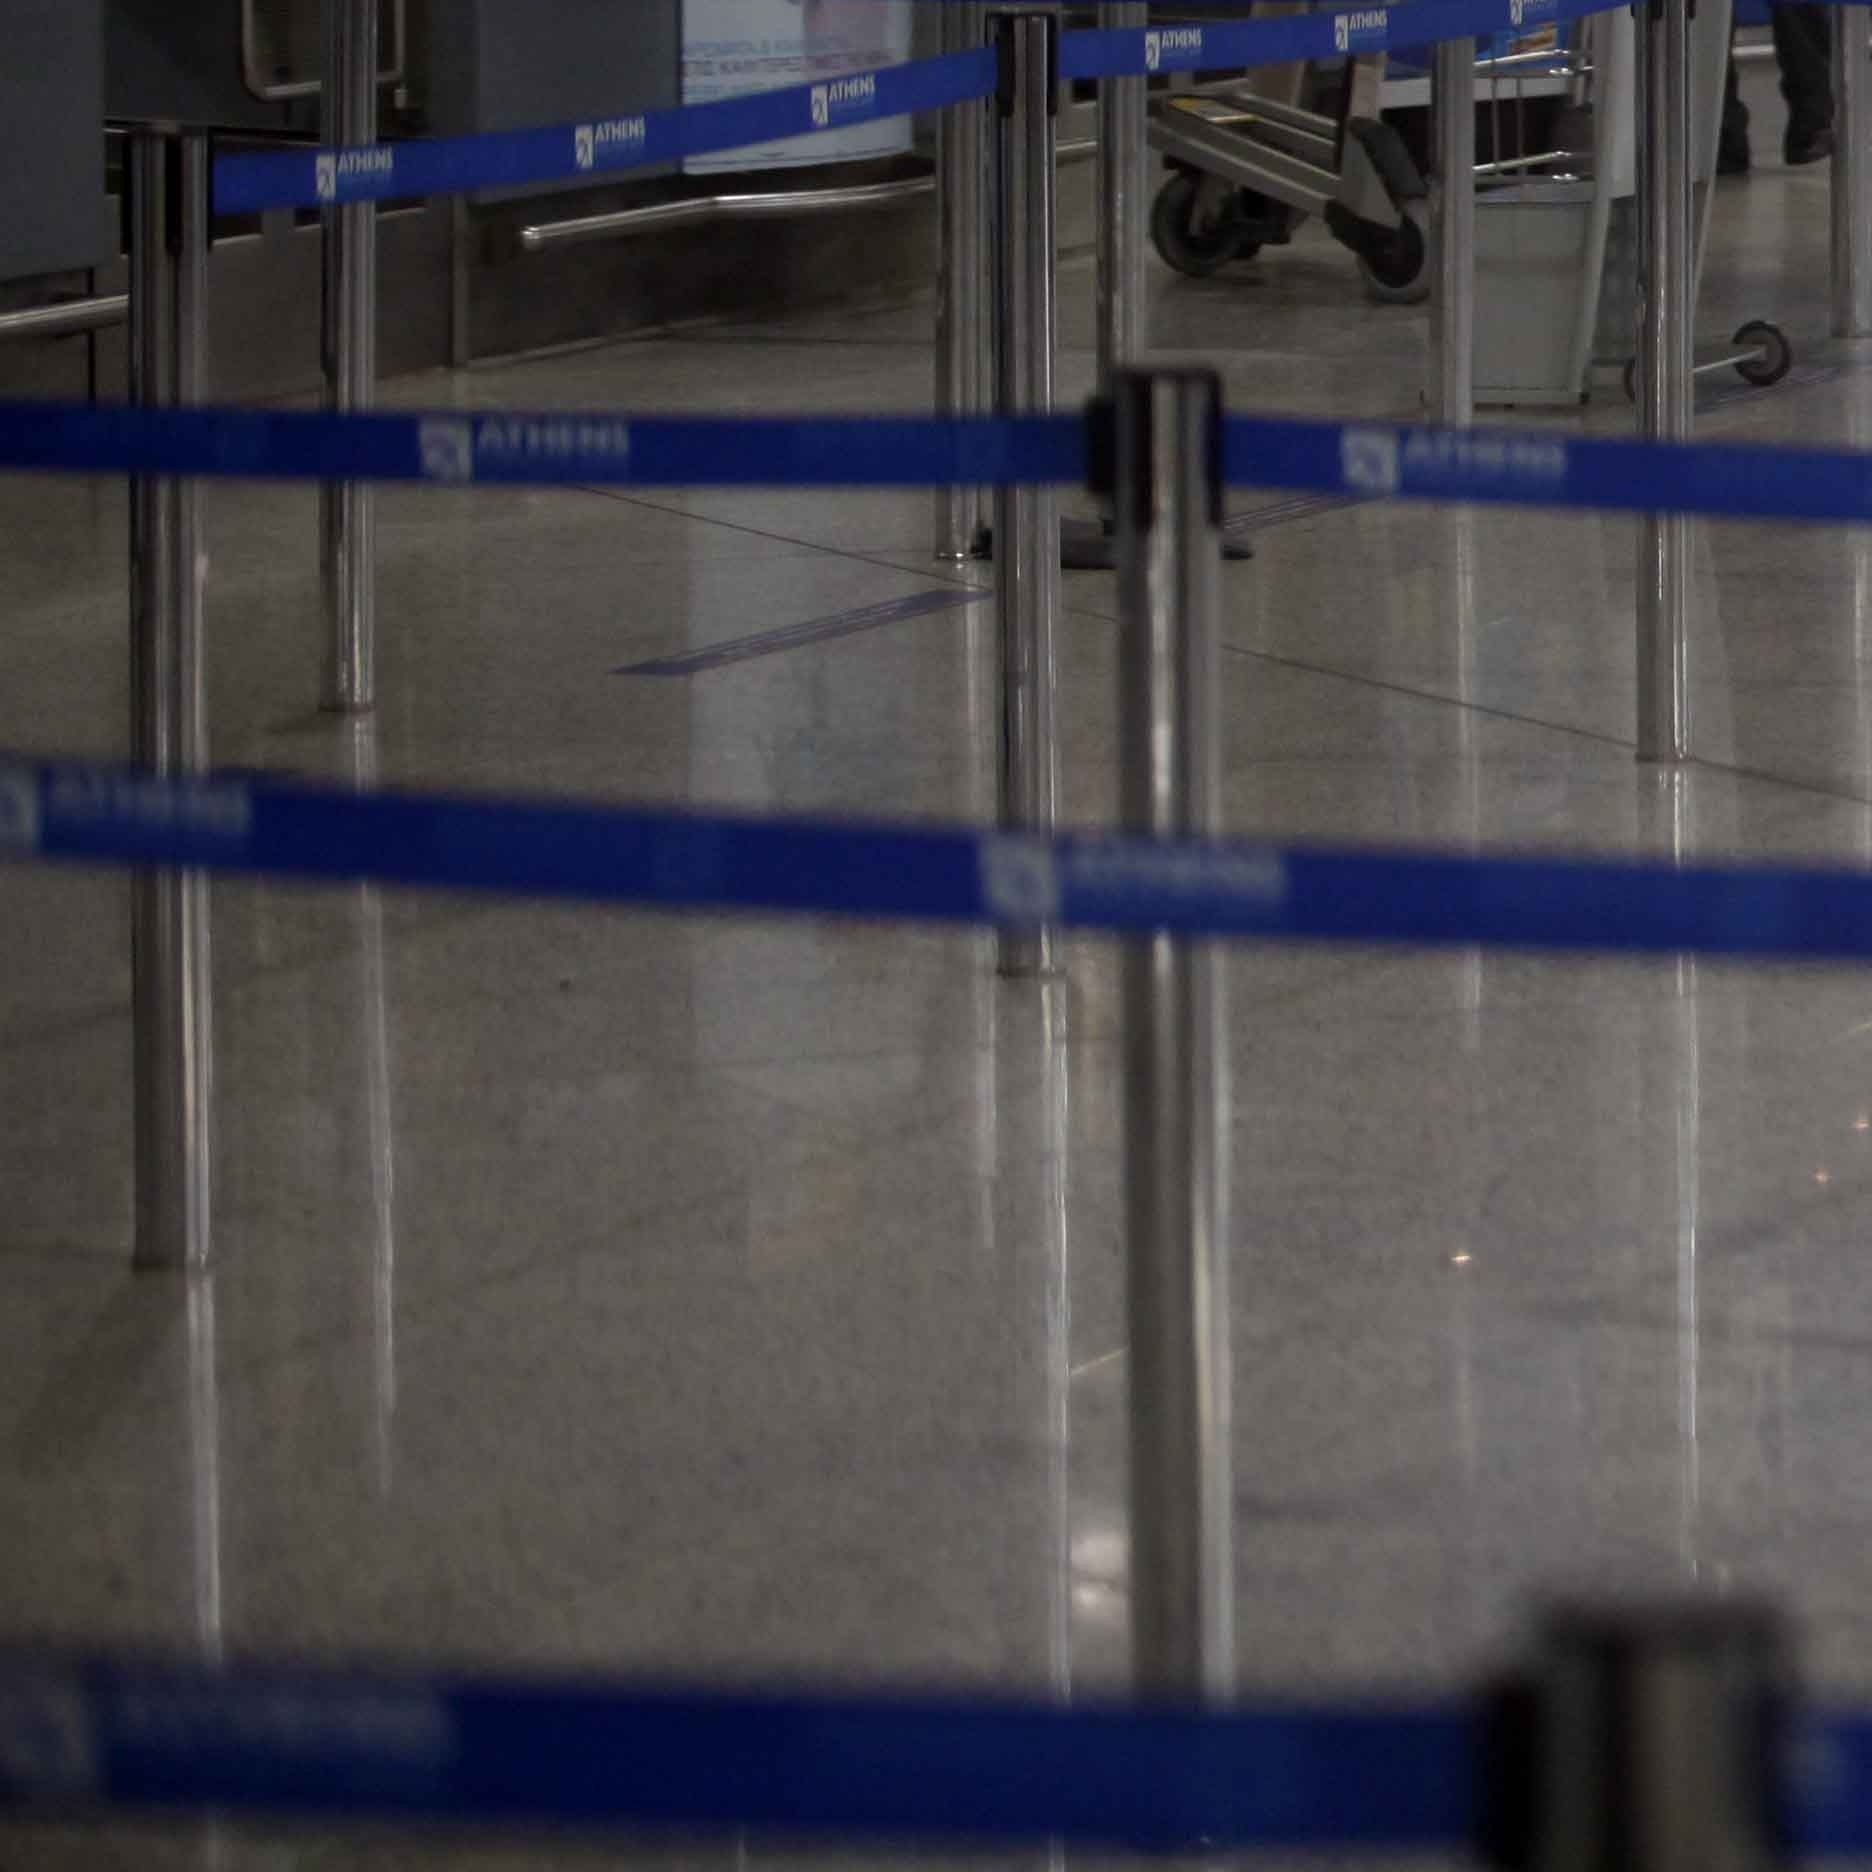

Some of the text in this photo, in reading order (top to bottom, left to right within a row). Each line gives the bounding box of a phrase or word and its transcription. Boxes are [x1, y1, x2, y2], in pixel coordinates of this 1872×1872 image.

[1349, 10, 1387, 29] ATHENS
[1162, 29, 1202, 48] ATHENS
[828, 74, 875, 102] ATHENS
[595, 116, 645, 142] ATHENS
[338, 149, 392, 174] ATHENS
